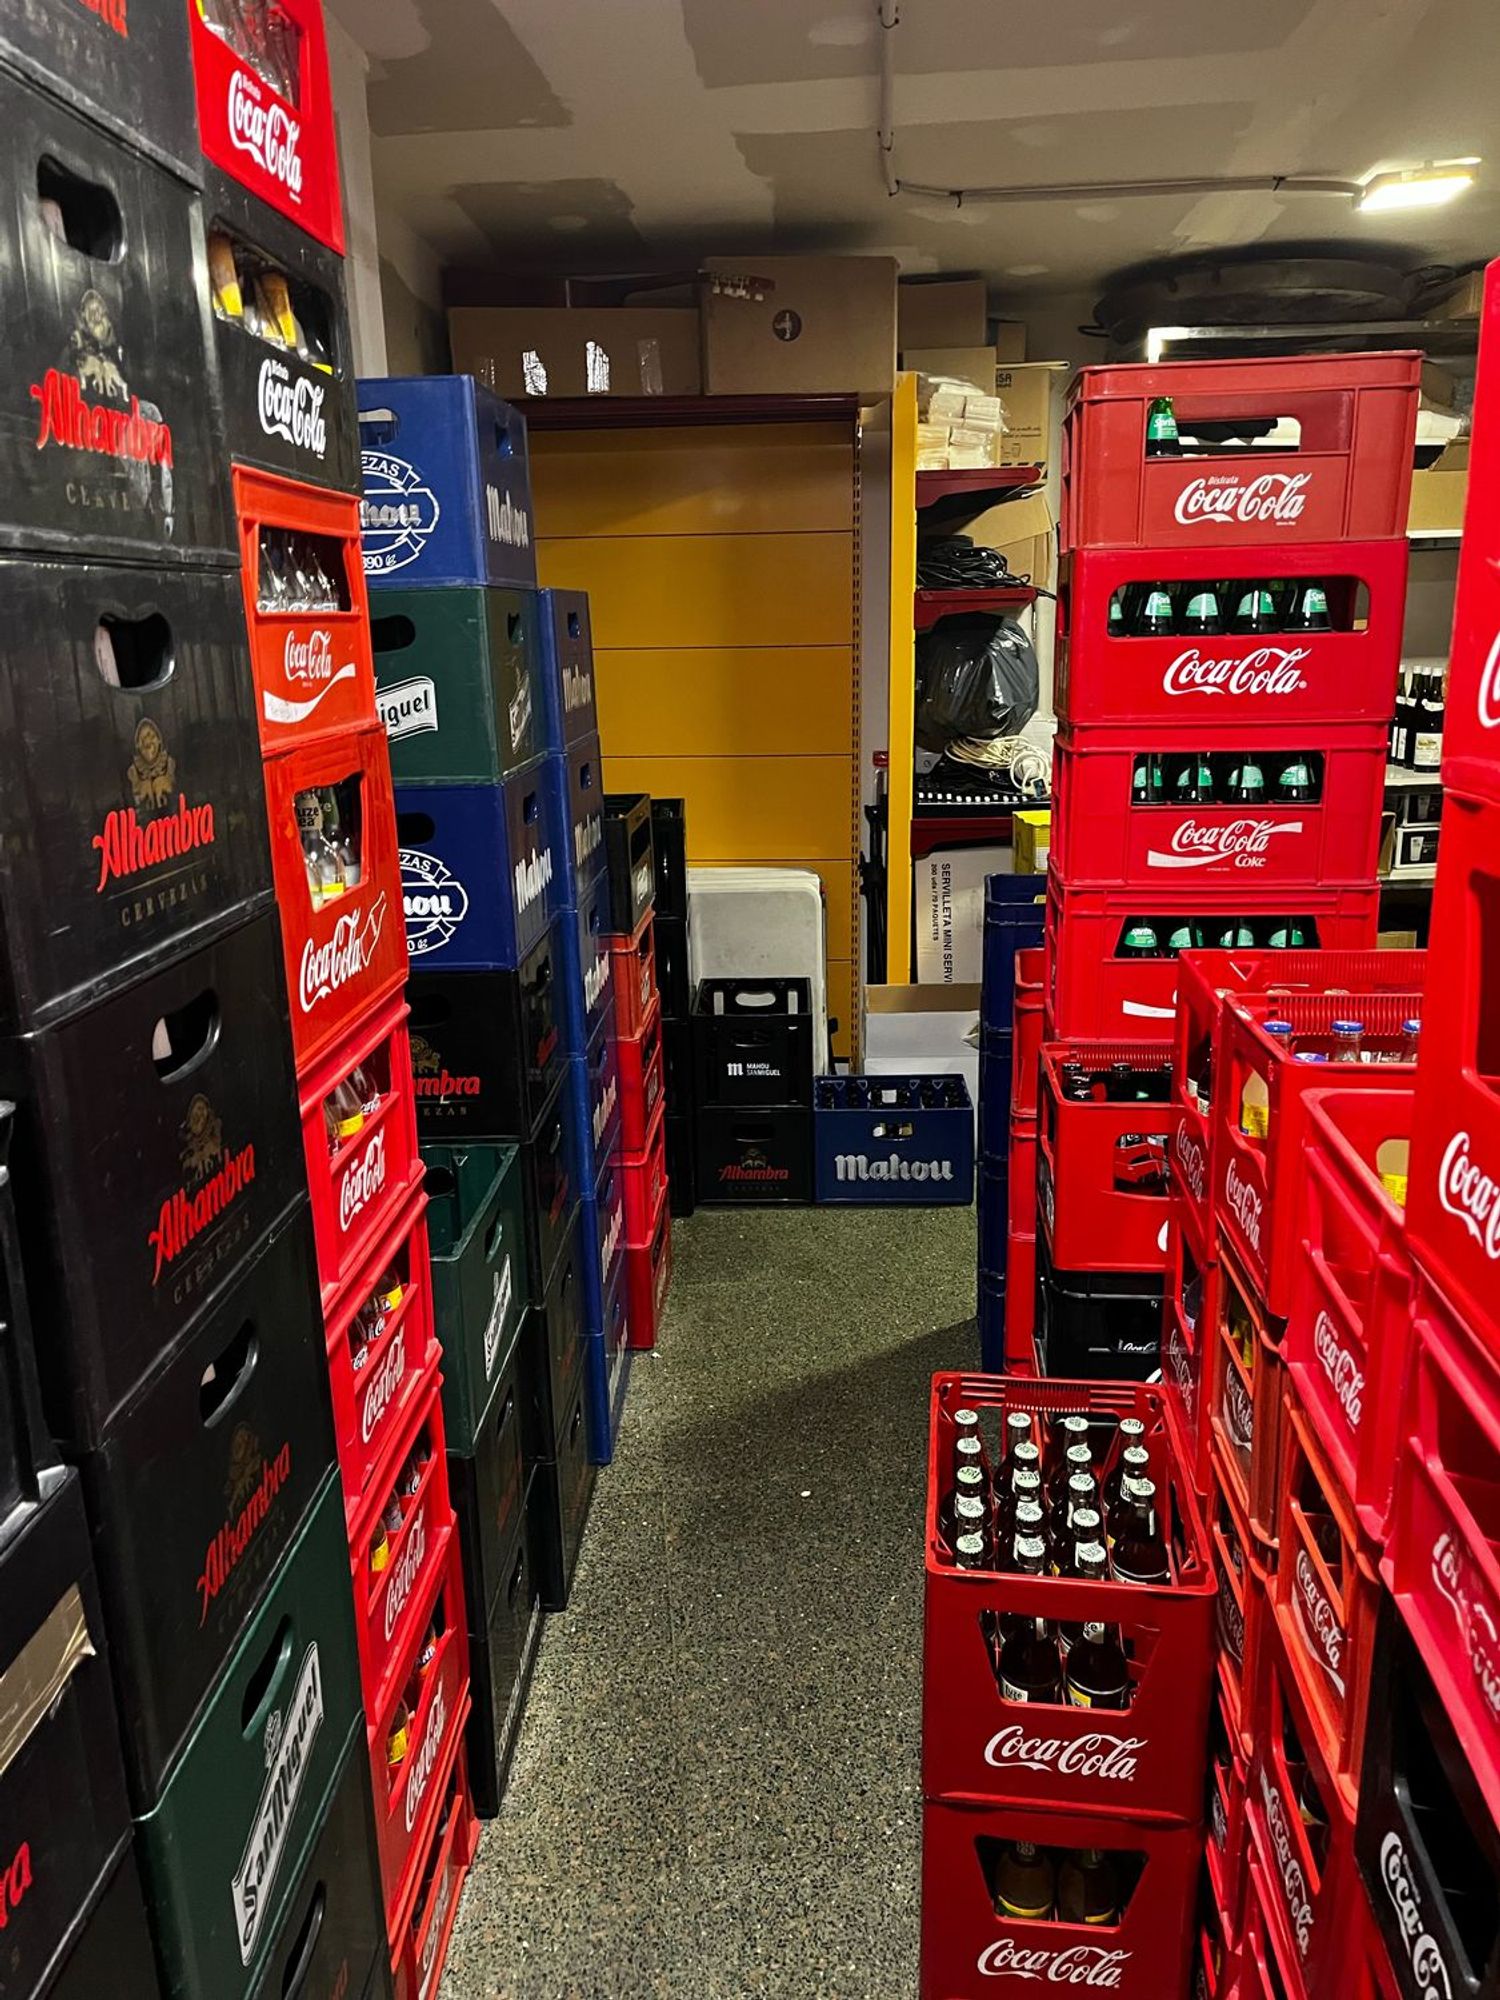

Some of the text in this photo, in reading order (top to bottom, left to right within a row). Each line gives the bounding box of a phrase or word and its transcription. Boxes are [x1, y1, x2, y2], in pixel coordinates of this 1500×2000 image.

[228, 69, 303, 193] Coca-Cola
[29, 370, 174, 469] Alhambra
[258, 358, 326, 452] Coca-Cola
[1174, 472, 1312, 525] Coca-Cola
[285, 630, 332, 681] Coca-Cola
[1163, 647, 1312, 695] Coca-Cola
[92, 801, 215, 893] Alhambra
[1171, 819, 1275, 852] Coca-Cola
[1234, 853, 1267, 868] Coke
[300, 907, 361, 1013] Coca-Cola
[835, 1154, 954, 1181] Mahou
[148, 1143, 256, 1286] Alhambra
[1315, 1310, 1366, 1426] Coca-Cola
[196, 1441, 292, 1630] Alhambra
[984, 1725, 1148, 1780] Coca-Cola
[977, 1938, 1133, 1987] Coca-Cola
